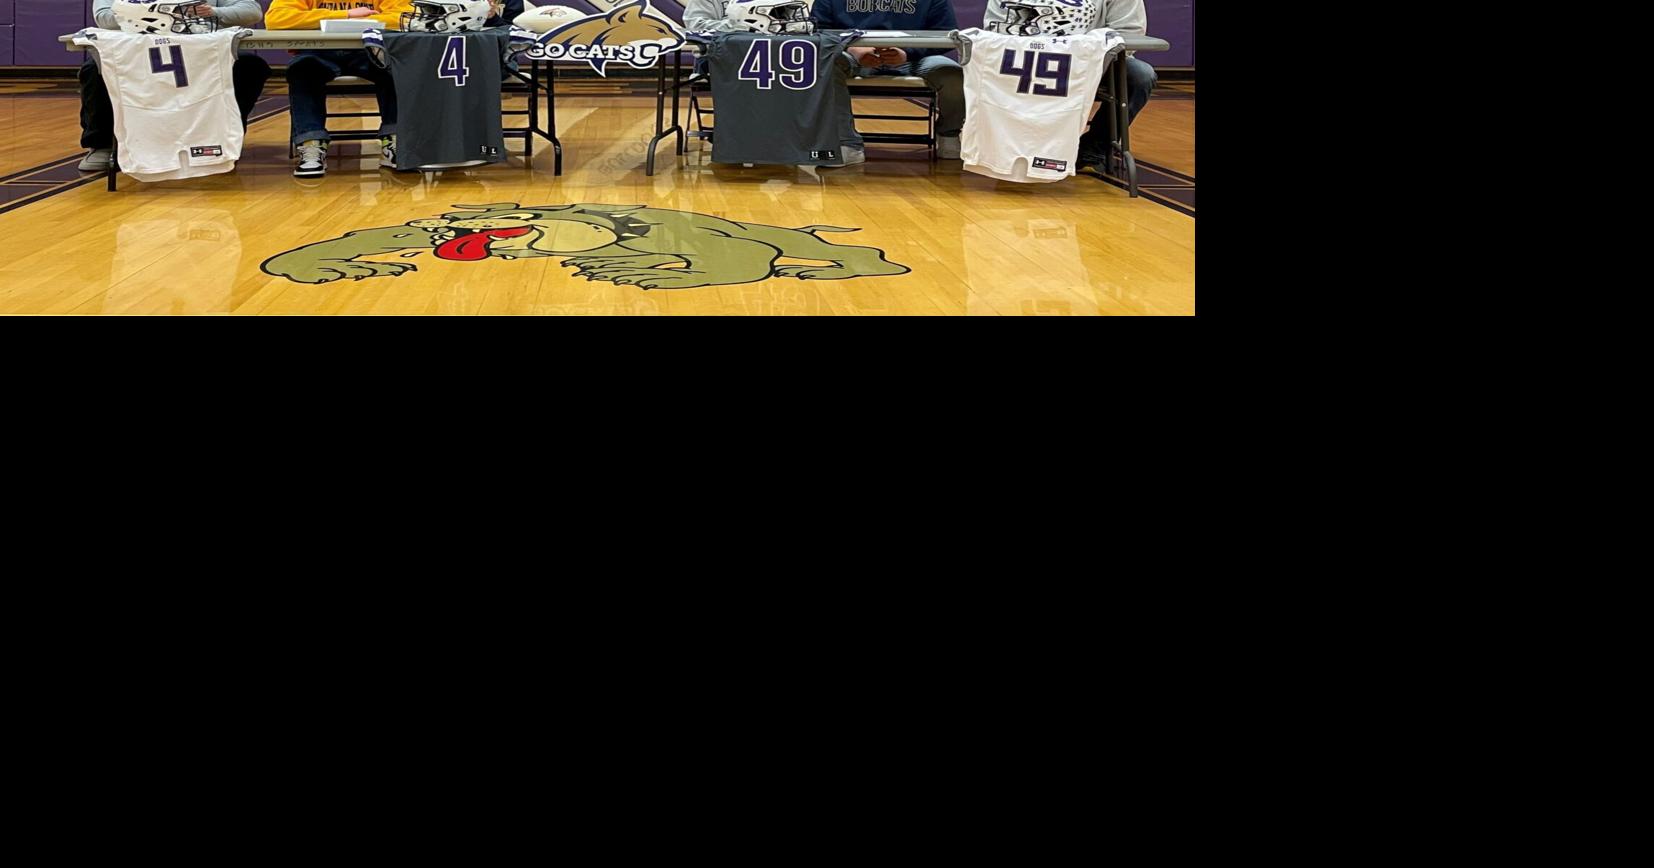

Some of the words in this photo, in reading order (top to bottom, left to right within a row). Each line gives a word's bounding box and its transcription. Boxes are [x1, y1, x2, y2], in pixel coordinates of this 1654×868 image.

[149, 45, 189, 88] 4
[438, 36, 469, 87] 4
[527, 42, 565, 58] GO
[568, 43, 635, 60] CATS
[738, 38, 818, 91] 49
[1000, 48, 1072, 97] 49
